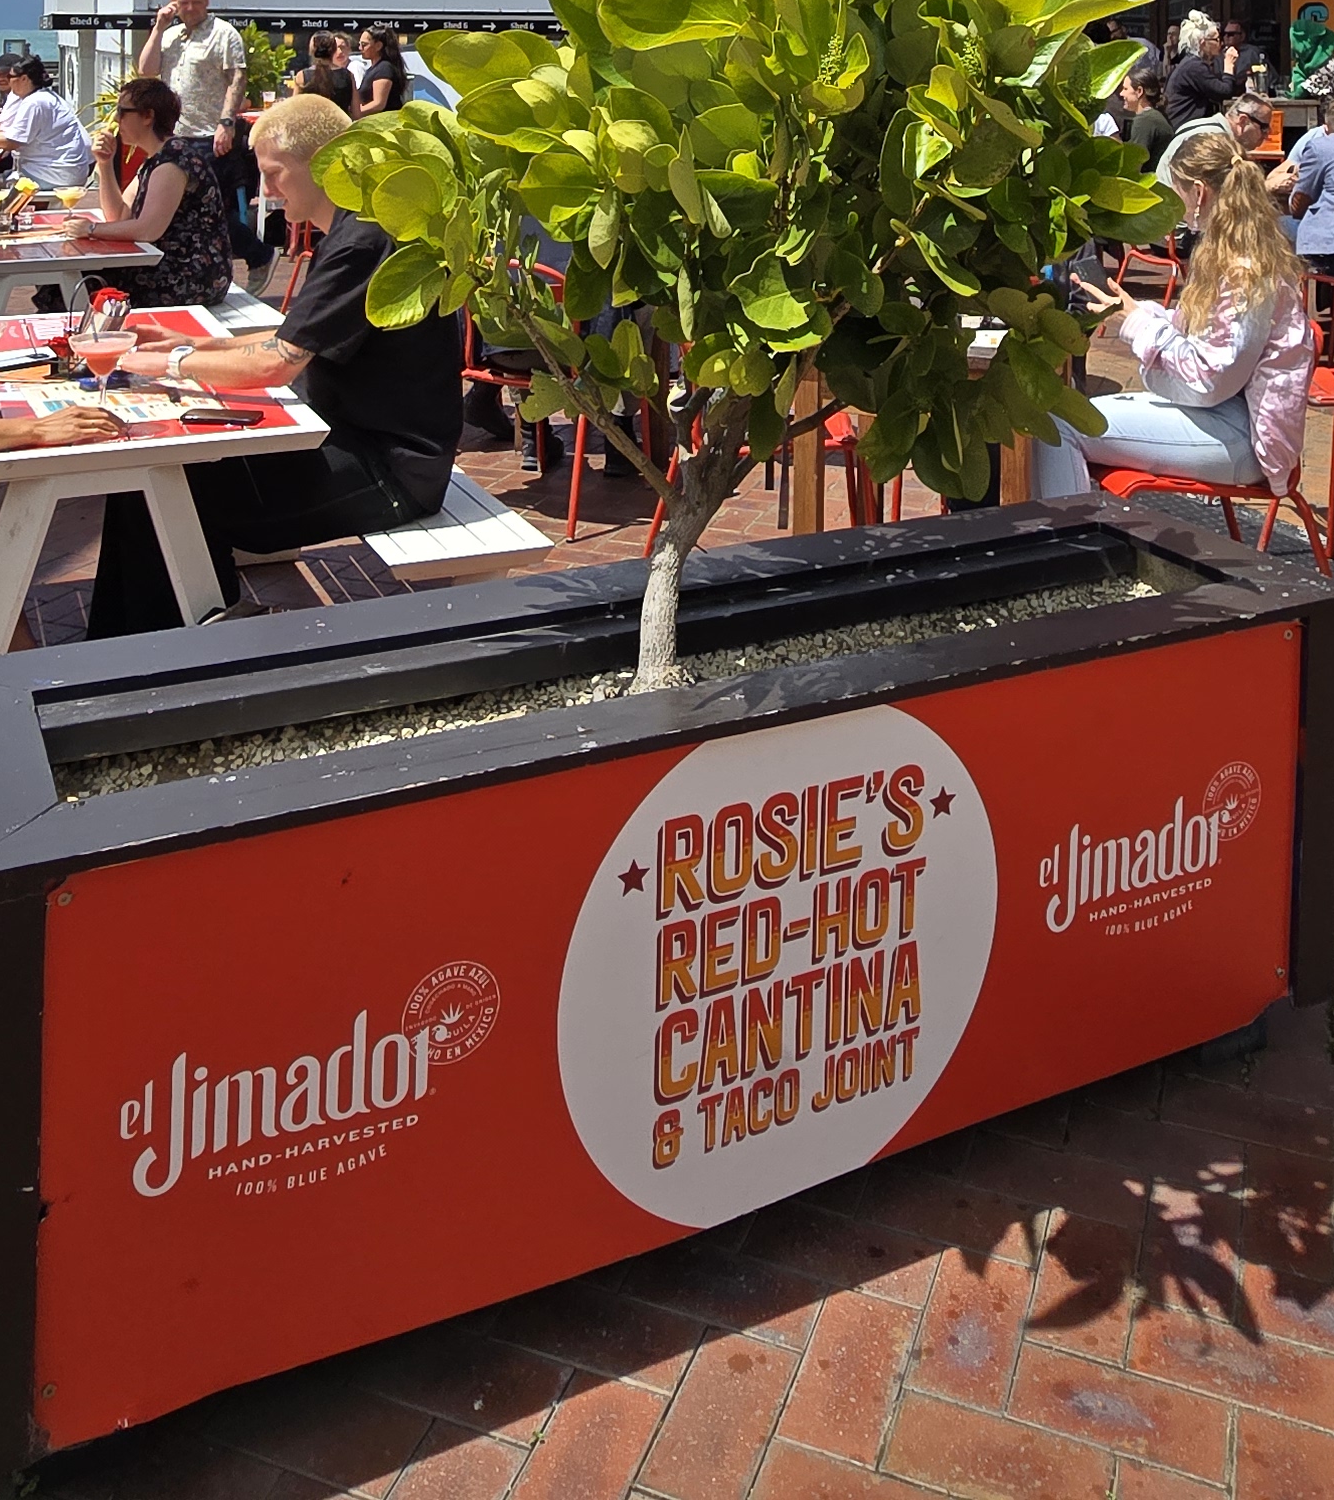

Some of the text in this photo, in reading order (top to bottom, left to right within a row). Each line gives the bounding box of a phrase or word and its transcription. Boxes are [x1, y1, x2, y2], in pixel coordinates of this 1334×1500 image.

[70, 17, 92, 26] Shed
[93, 17, 100, 26] 6
[302, 20, 329, 28] Shed 6
[394, 20, 400, 29] 6
[444, 21, 469, 29] Shed 6
[511, 21, 535, 30] Shed 6
[656, 764, 925, 920] ROSIE'S
[1039, 795, 1231, 933] el Jimador
[1089, 878, 1212, 922] HAND-HARVESTED
[1105, 900, 1193, 936] 100% BLUE AGAVE
[656, 857, 926, 1013] RED-HOT
[408, 965, 491, 1014] 100% AGAVE AZUL
[446, 1046, 461, 1060] EN
[465, 1007, 494, 1049] MEXICO
[654, 940, 921, 1106] CANTINA
[120, 1009, 449, 1197] el Jimador
[653, 1027, 920, 1170] & TACO JOINT
[208, 1114, 419, 1180] HAND-HARVESTED
[236, 1143, 387, 1196] 100% BLUE AGAVE
